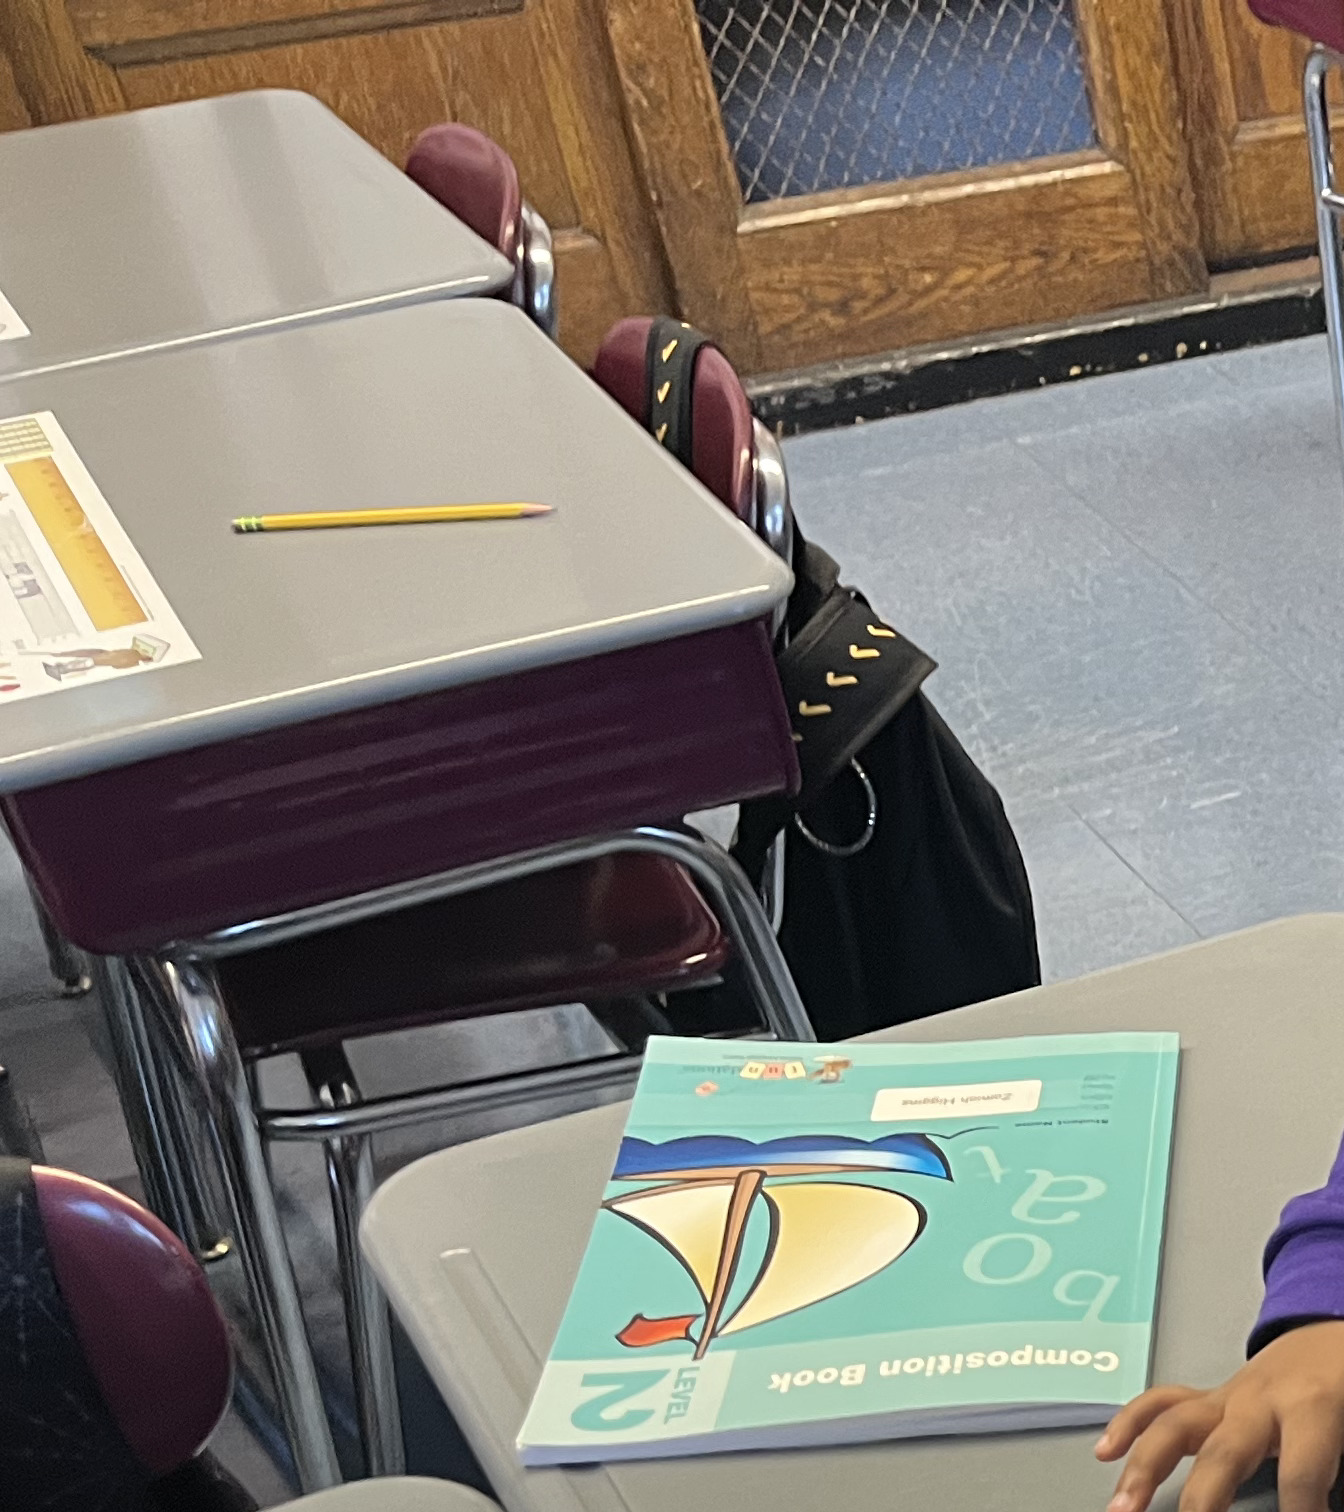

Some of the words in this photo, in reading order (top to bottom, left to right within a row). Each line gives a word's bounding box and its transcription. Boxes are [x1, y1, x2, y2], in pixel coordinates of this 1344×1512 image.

[768, 1363, 866, 1393] Book
[879, 1345, 1120, 1377] Composition
[571, 1368, 671, 1432] 2
[664, 1366, 700, 1425] LEVEL
